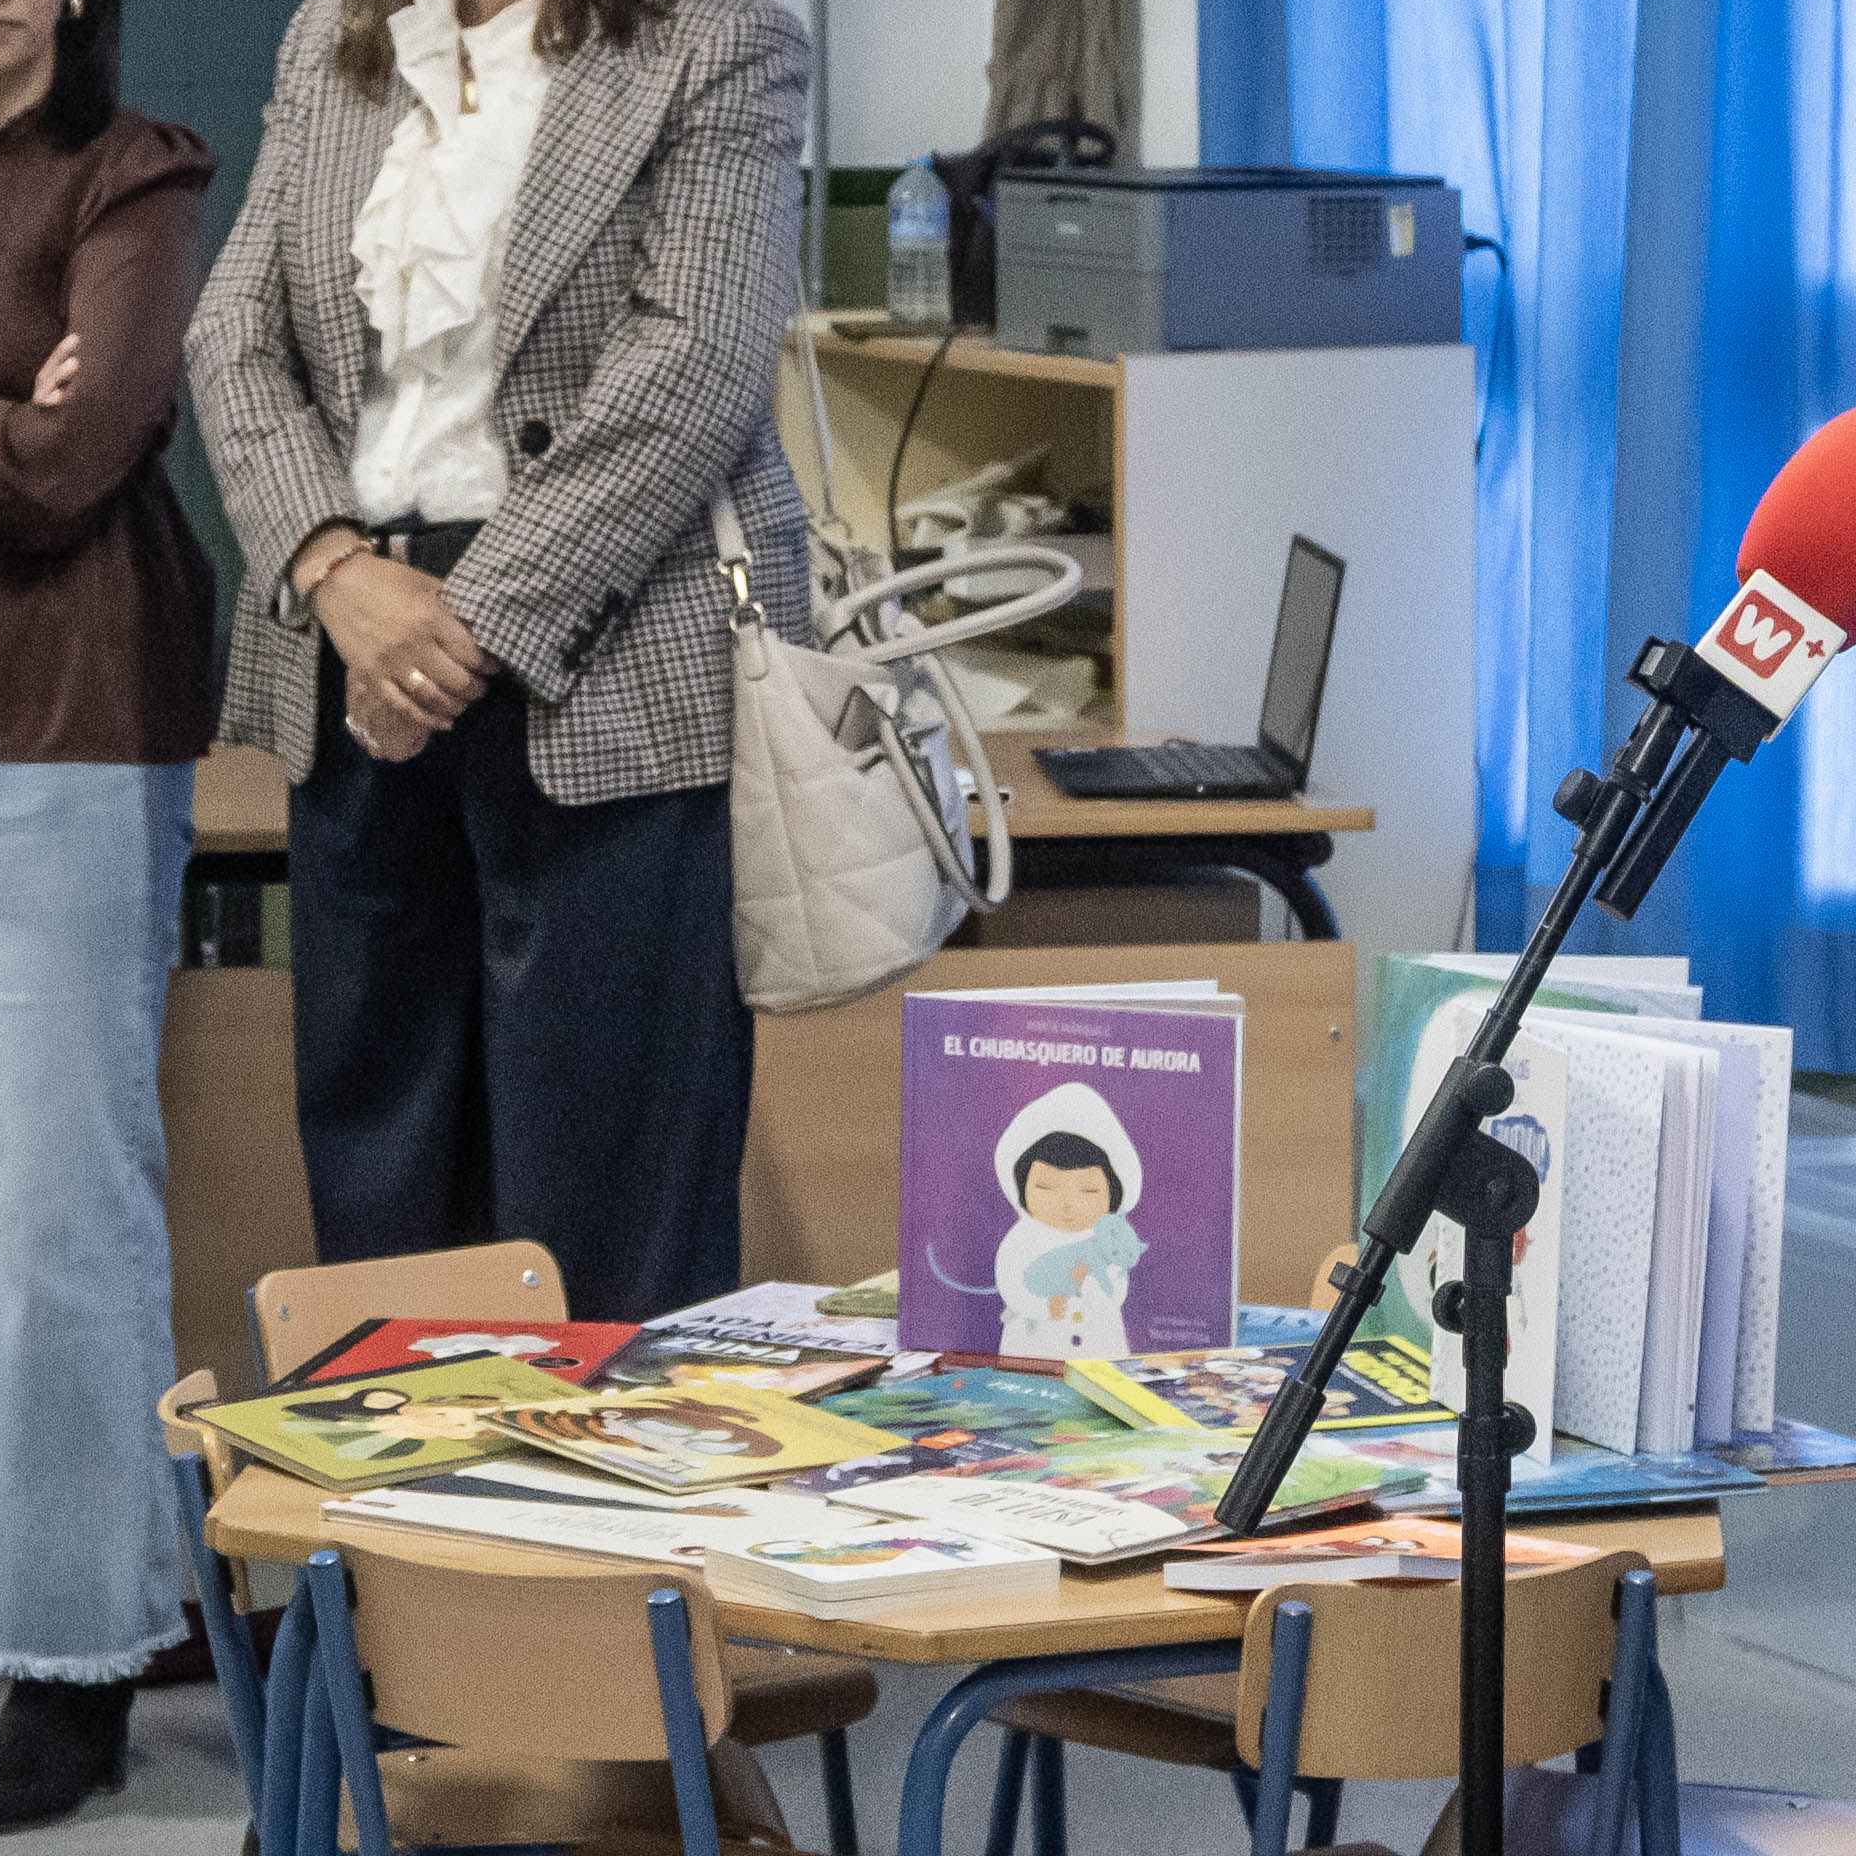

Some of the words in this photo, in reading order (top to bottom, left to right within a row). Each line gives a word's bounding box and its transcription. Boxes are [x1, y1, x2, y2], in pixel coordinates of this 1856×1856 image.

[944, 1034, 965, 1056] EL
[969, 1037, 1097, 1066] CHUBASQUERO
[1101, 1045, 1125, 1068] DE
[1130, 1048, 1201, 1074] AURORA
